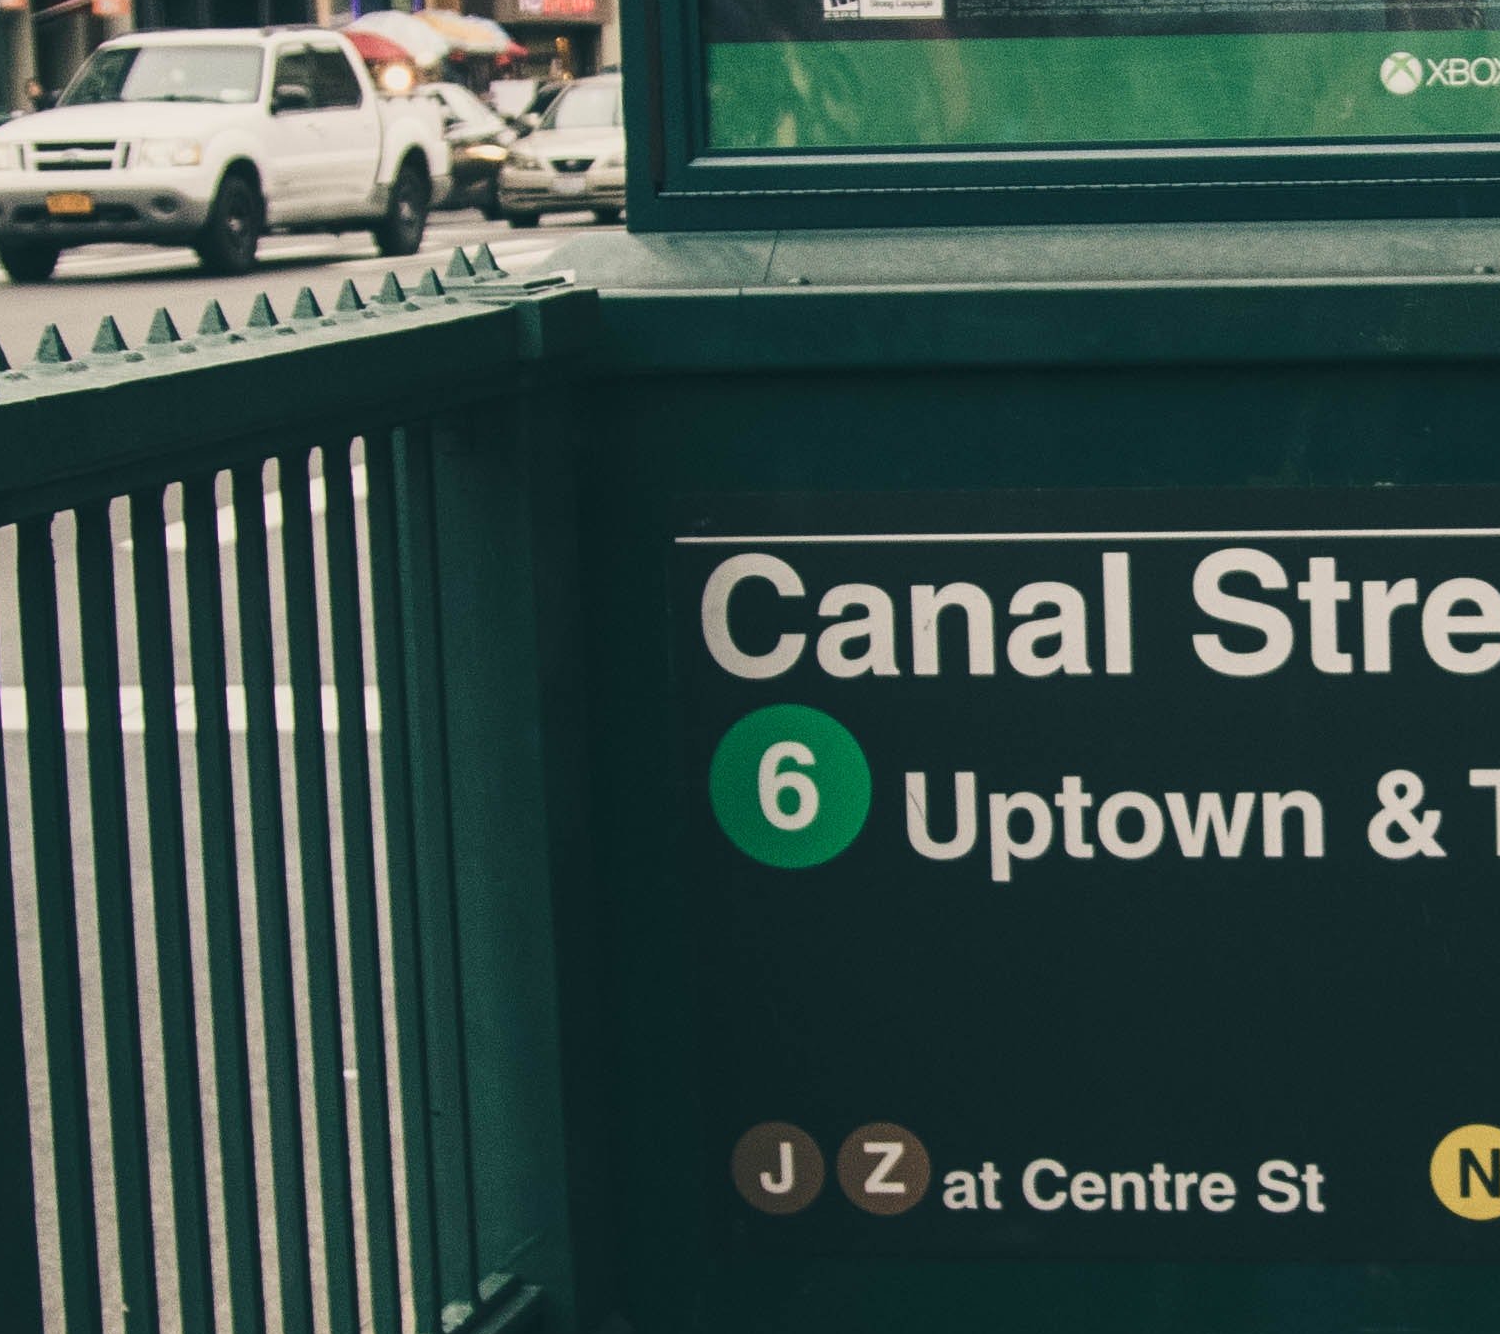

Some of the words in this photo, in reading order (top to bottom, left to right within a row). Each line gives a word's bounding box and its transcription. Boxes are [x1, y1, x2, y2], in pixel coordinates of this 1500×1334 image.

[701, 552, 1133, 680] Canal
[756, 740, 821, 832] 6
[905, 771, 1324, 882] Uptown
[1367, 769, 1447, 860] &
[760, 1141, 795, 1194] J
[862, 1142, 905, 1194] Z
[942, 1162, 1002, 1211] at
[1022, 1158, 1236, 1213] Centre
[1257, 1159, 1326, 1213] St
